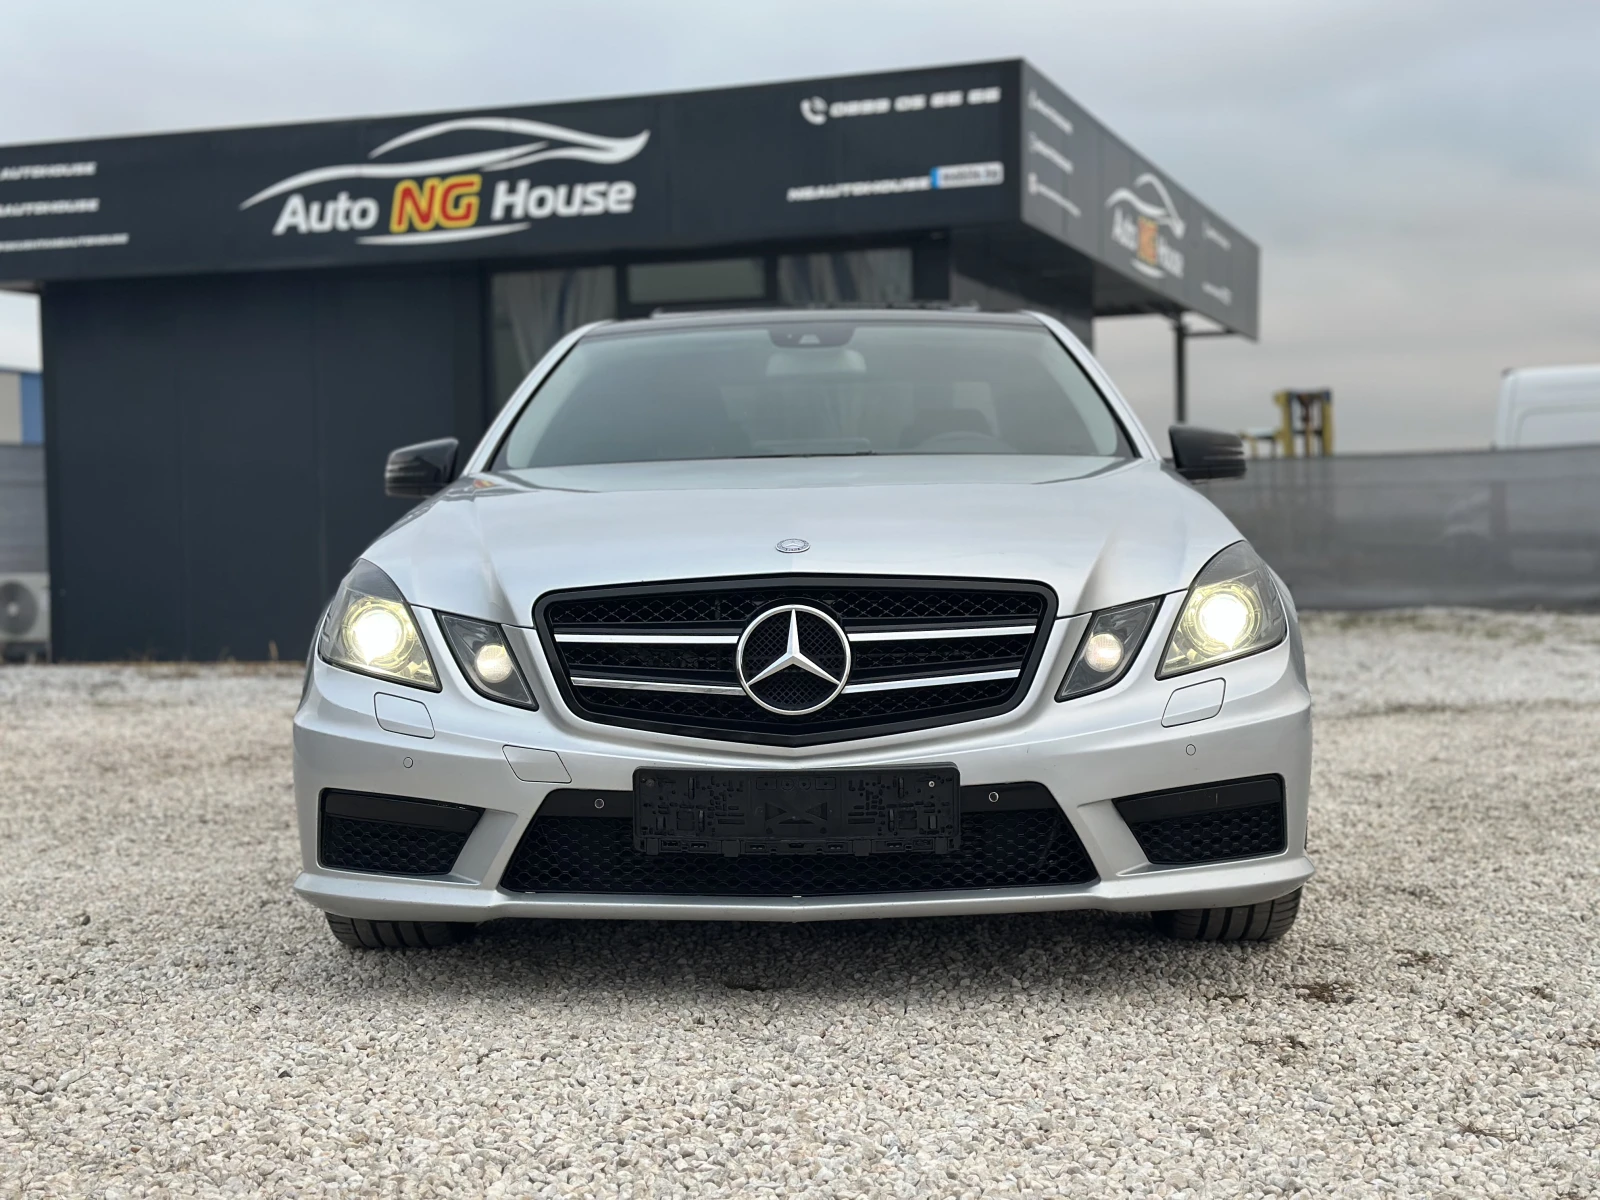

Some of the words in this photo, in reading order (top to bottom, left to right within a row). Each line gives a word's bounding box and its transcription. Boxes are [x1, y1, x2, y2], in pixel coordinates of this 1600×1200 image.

[272, 191, 378, 236] Auto
[389, 174, 482, 233] NG
[491, 178, 636, 221] House
